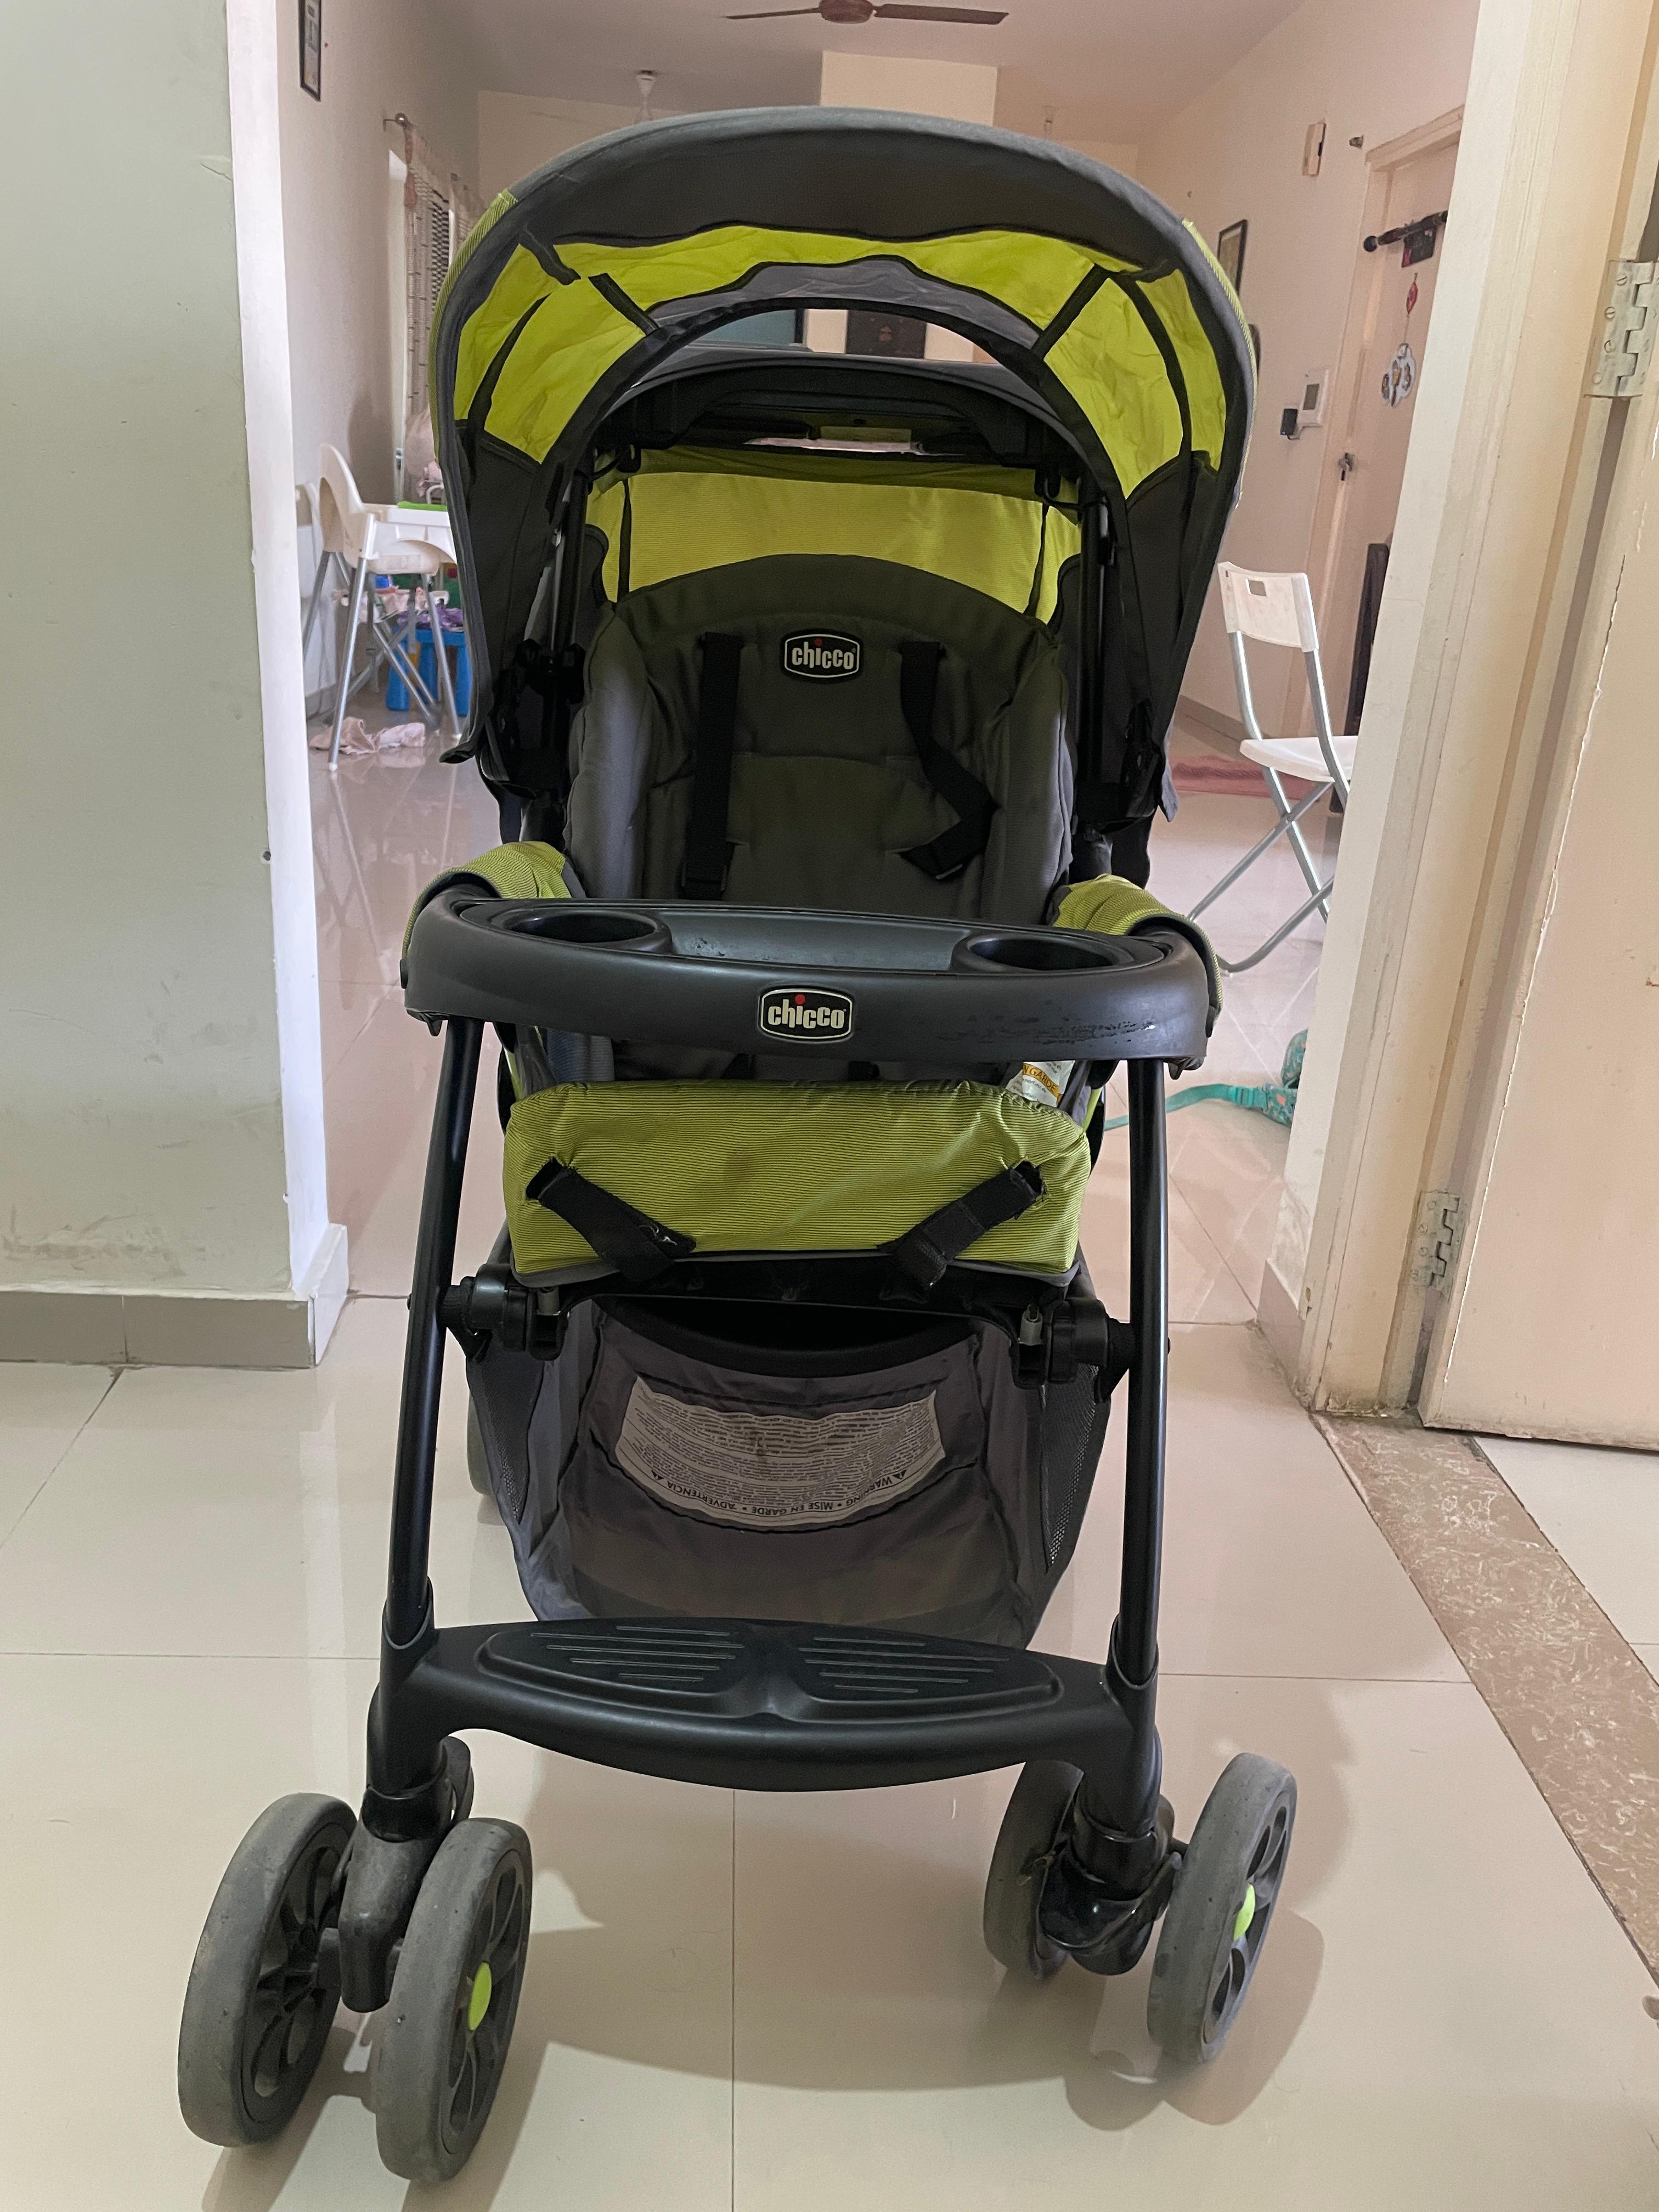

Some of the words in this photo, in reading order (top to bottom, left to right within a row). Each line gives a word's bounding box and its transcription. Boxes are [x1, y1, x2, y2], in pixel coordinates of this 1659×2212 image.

[792, 637, 854, 669] chicco
[768, 994, 845, 1029] chicco
[1030, 1067, 1057, 1093] GARDE
[667, 1480, 736, 1509] ADVERTENCIA
[808, 1502, 833, 1510] MISE
[751, 1506, 788, 1516] GARDE
